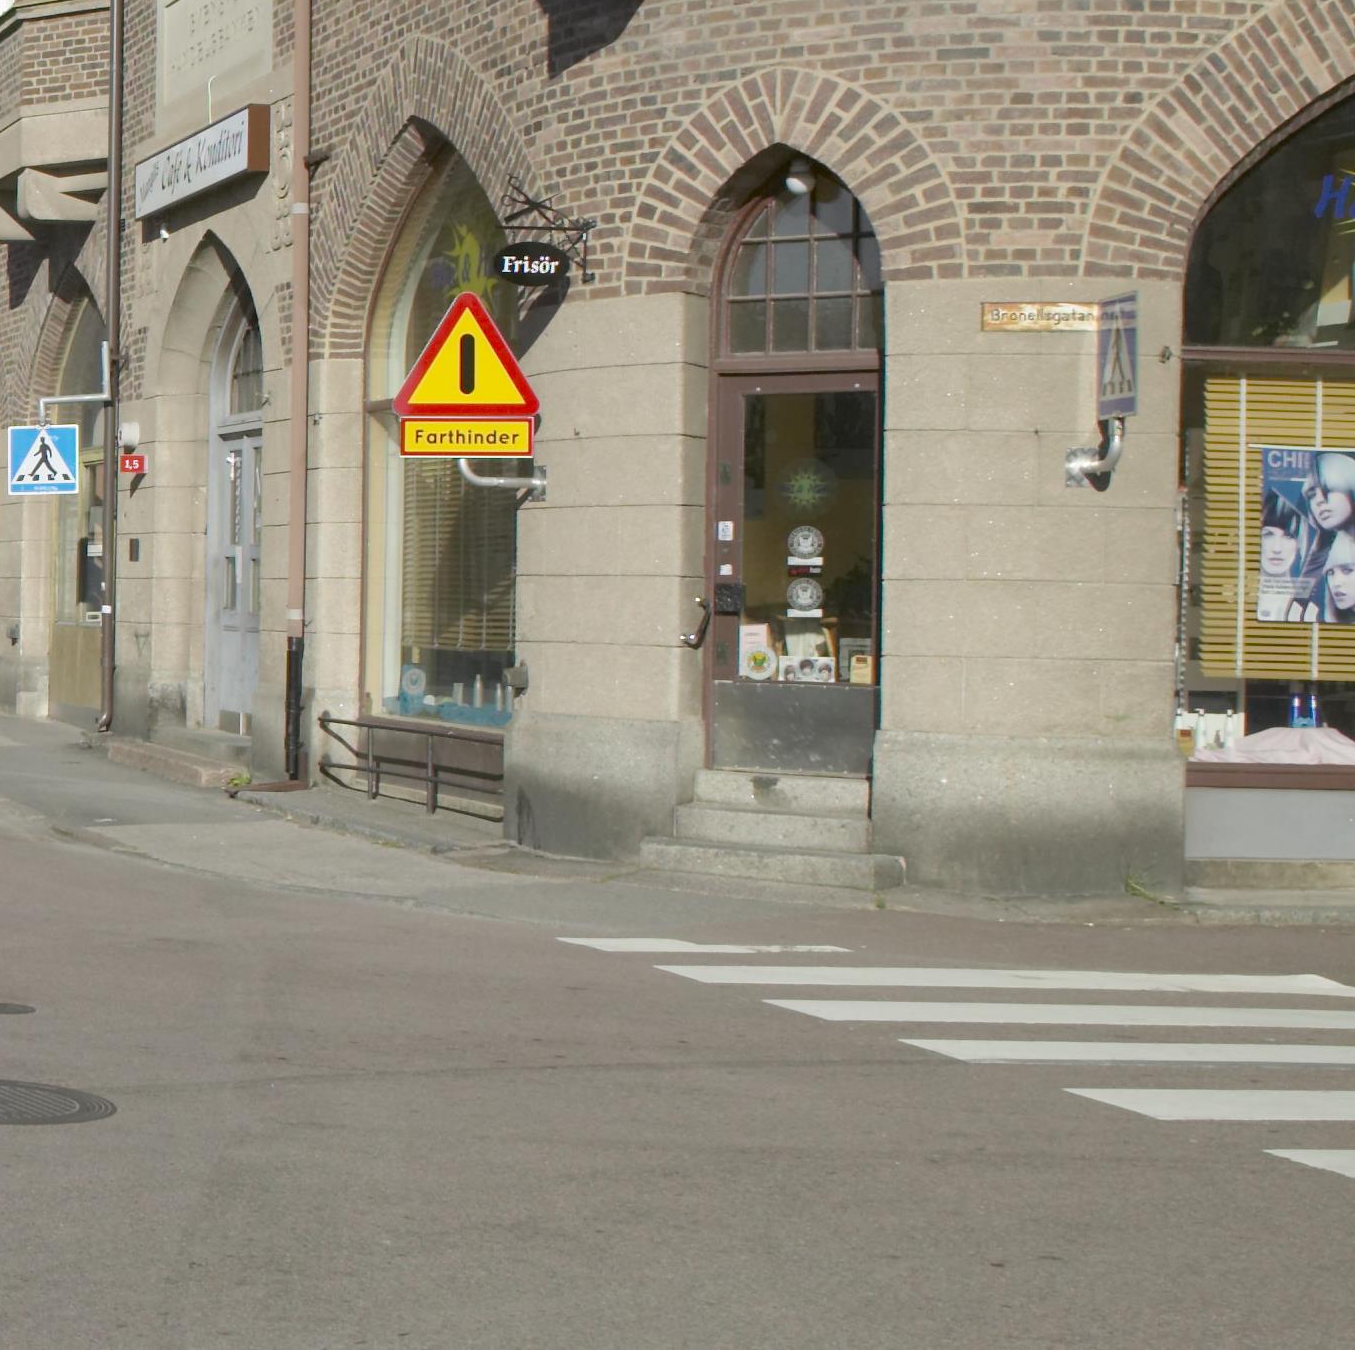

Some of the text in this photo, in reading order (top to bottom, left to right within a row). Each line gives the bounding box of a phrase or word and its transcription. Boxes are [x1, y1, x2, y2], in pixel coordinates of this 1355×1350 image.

[195, 121, 245, 173] Konditori
[1314, 174, 1355, 218] H
[502, 256, 560, 274] Frisör
[415, 430, 519, 444] Farthinder
